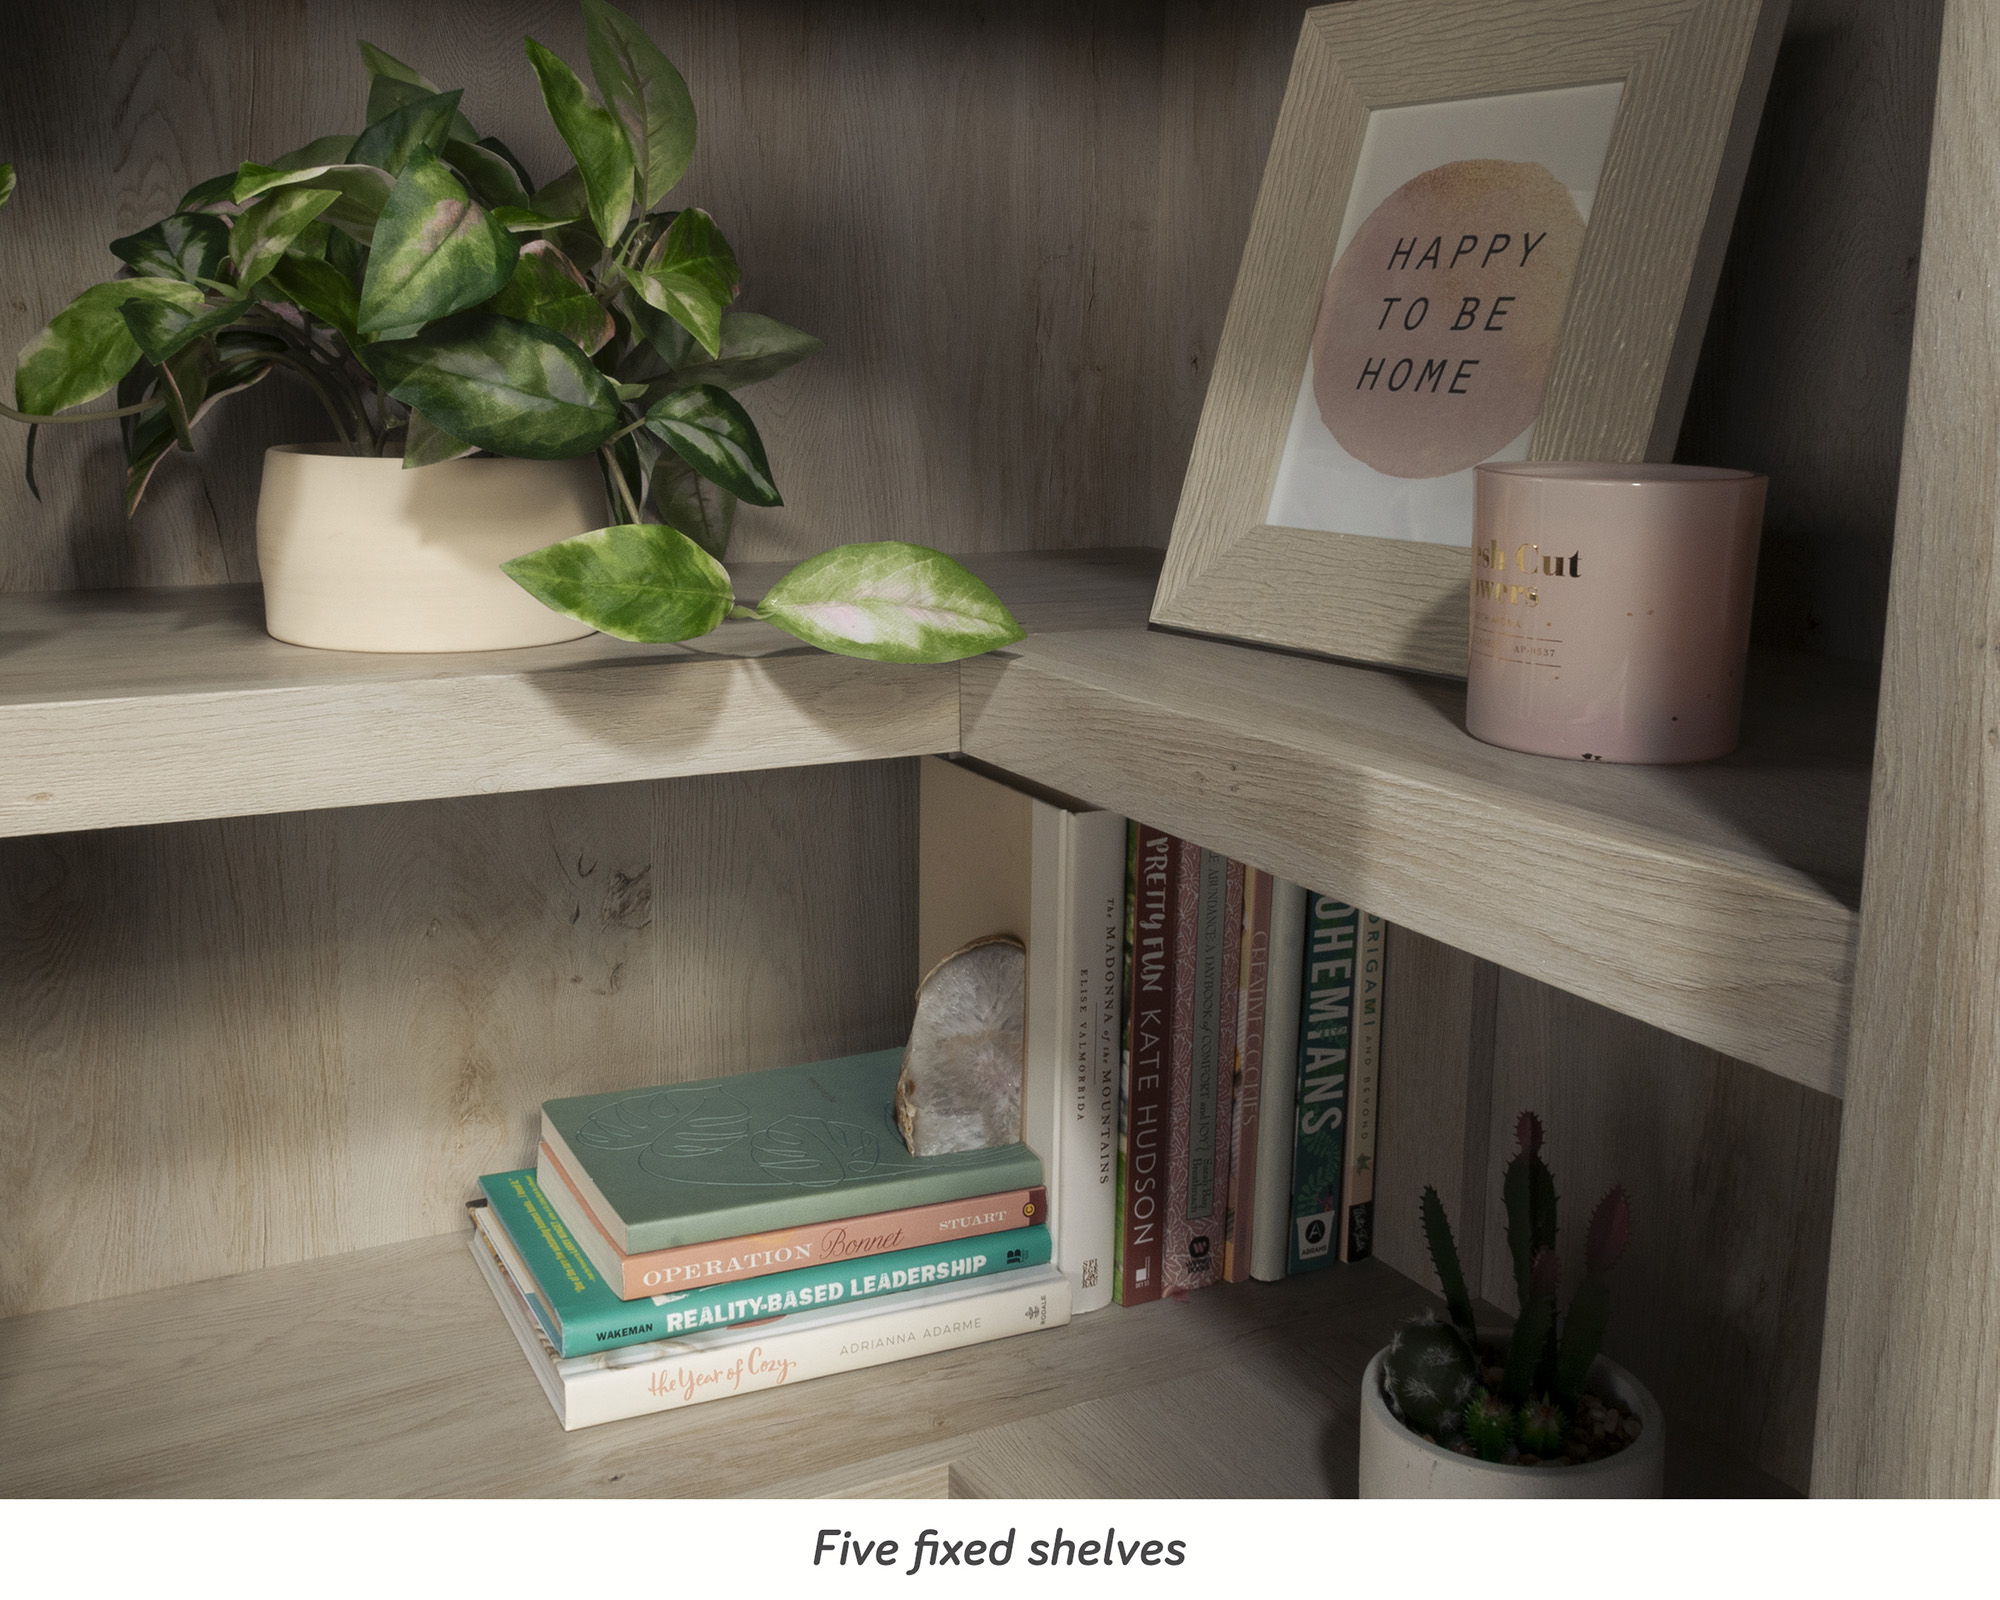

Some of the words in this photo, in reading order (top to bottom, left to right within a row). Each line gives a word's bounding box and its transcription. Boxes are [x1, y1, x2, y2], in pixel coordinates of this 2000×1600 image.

[1387, 232, 1547, 270] HAPPY
[1378, 297, 1429, 330] TO
[1450, 296, 1516, 331] BE
[1356, 358, 1480, 393] HOME
[1515, 544, 1582, 578] Cut
[1106, 898, 1115, 918] The
[1079, 969, 1088, 1012] ELISE
[1104, 926, 1116, 1023] MADONNA
[1140, 937, 1165, 991] FUN
[1248, 931, 1268, 1026] CREATIVE
[1101, 1030, 1110, 1042] of
[1102, 1047, 1110, 1063] the
[1137, 1009, 1161, 1091] KATE
[1364, 1036, 1372, 1066] AND
[1077, 1022, 1087, 1121] VALMORBIDA
[1242, 1033, 1262, 1126] COOKIES
[1100, 1069, 1112, 1185] MOUNTAINS
[1361, 1077, 1371, 1140] BEYOND
[1134, 1104, 1158, 1245] HUDSON
[643, 1243, 813, 1286] OPERATION
[820, 1227, 904, 1259] Bonnet
[939, 1211, 1007, 1231] STUART
[596, 1323, 653, 1342] WAKEMAN
[667, 1281, 844, 1333] REALITY-BASED
[850, 1255, 987, 1297] LEADERSHIP
[648, 1372, 676, 1397] the
[677, 1367, 722, 1400] Year
[726, 1359, 744, 1389] of
[747, 1347, 797, 1384] Cozy
[840, 1332, 916, 1356] ADRIANNA
[923, 1318, 982, 1339] ADARME
